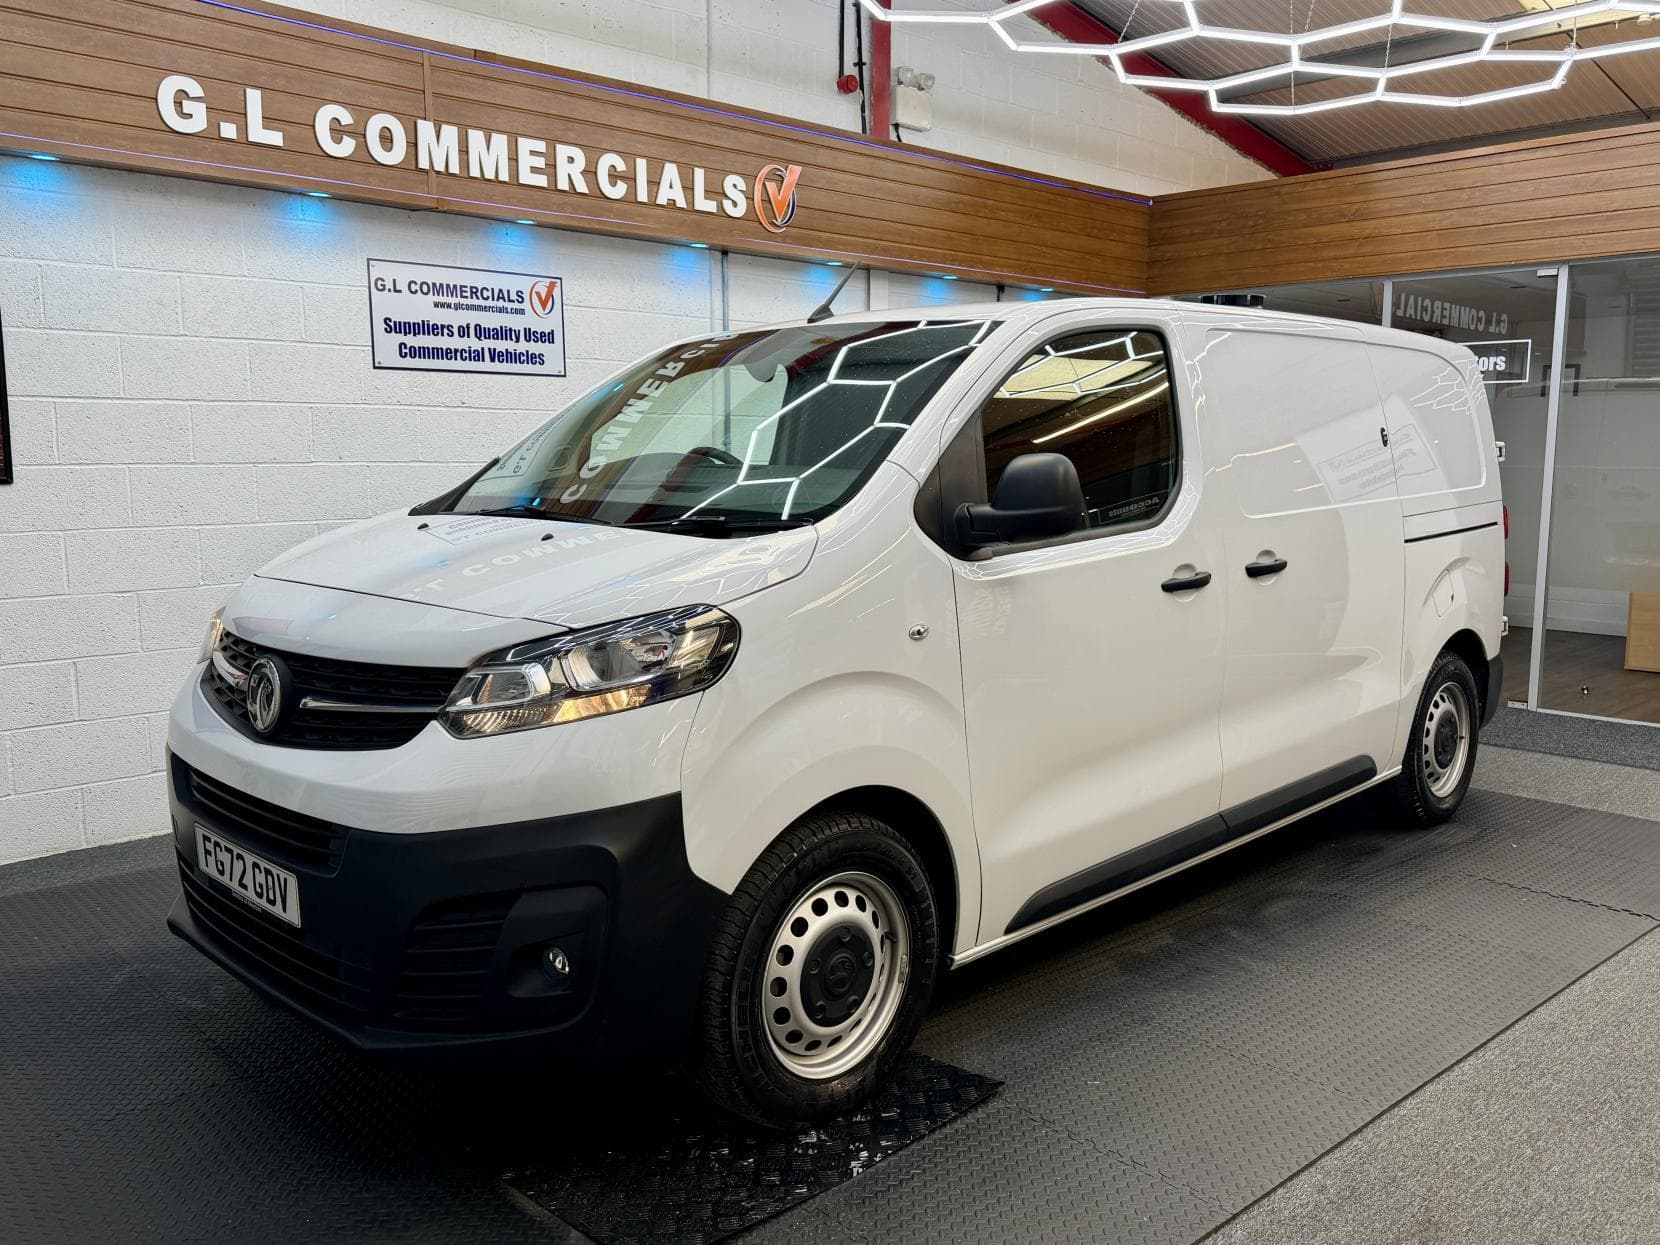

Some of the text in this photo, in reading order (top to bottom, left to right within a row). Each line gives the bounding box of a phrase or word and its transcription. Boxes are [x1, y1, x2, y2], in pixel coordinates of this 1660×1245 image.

[156, 74, 748, 219] G.L COMMERCIALS
[373, 276, 526, 304] G.L COMMERCIALS
[432, 299, 526, 316] www.glcommercials.com
[383, 316, 555, 344] Suppliers of Quality Used
[398, 341, 545, 366] Commercial Vehicles
[1476, 356, 1506, 371] ors
[201, 833, 249, 892] FG72
[251, 861, 288, 914] GDV
